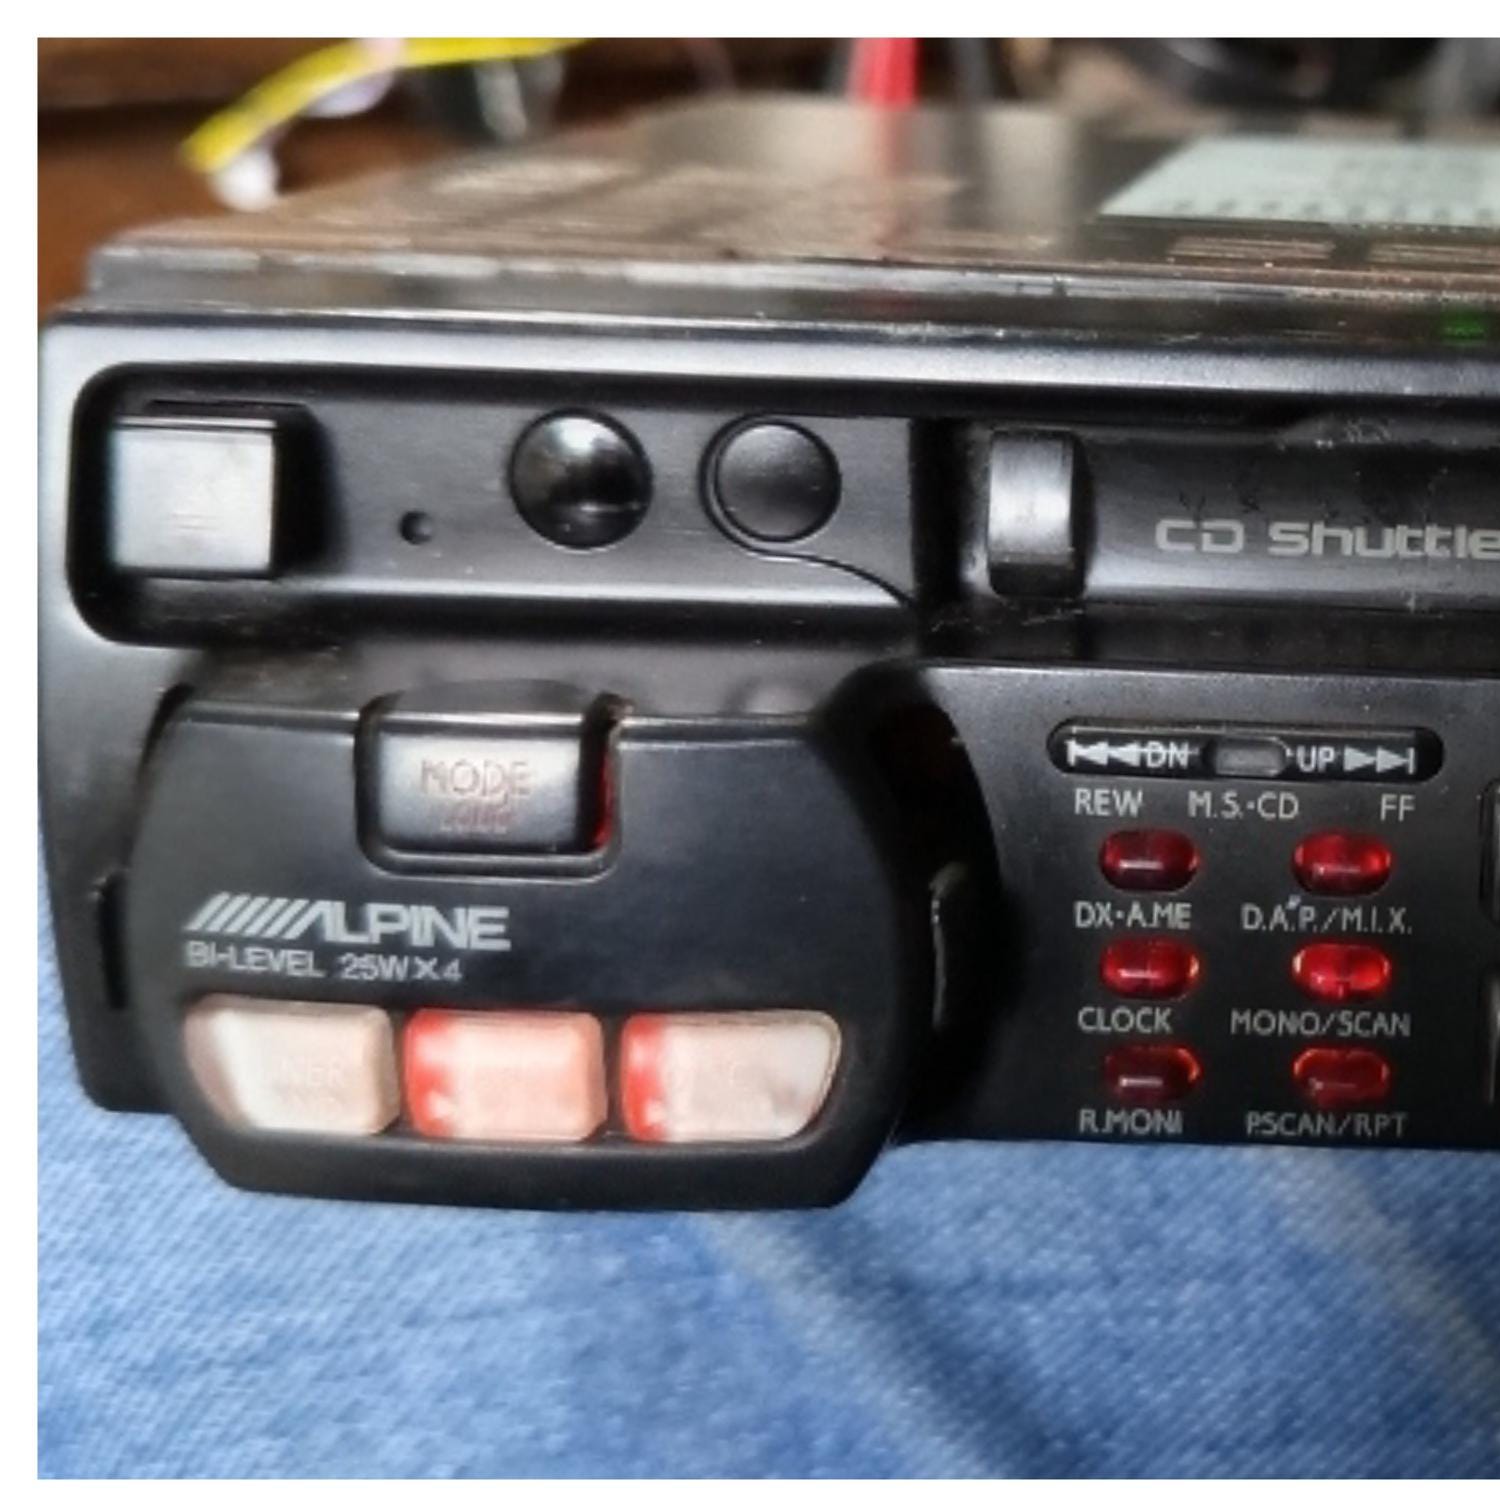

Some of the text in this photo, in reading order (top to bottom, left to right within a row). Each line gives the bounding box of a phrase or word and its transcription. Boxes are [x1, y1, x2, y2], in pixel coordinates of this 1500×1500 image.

[1155, 519, 1243, 554] CD
[1146, 741, 1190, 768] DN
[1297, 747, 1335, 772] UP
[420, 759, 532, 797] MODE
[1074, 788, 1143, 819] REW
[1380, 794, 1416, 821] FF
[276, 892, 510, 950] ALPINE
[185, 942, 324, 981] BI-LEVEL
[1077, 1006, 1173, 1034] CLOCK
[1229, 1009, 1411, 1038] MONO/SCAN
